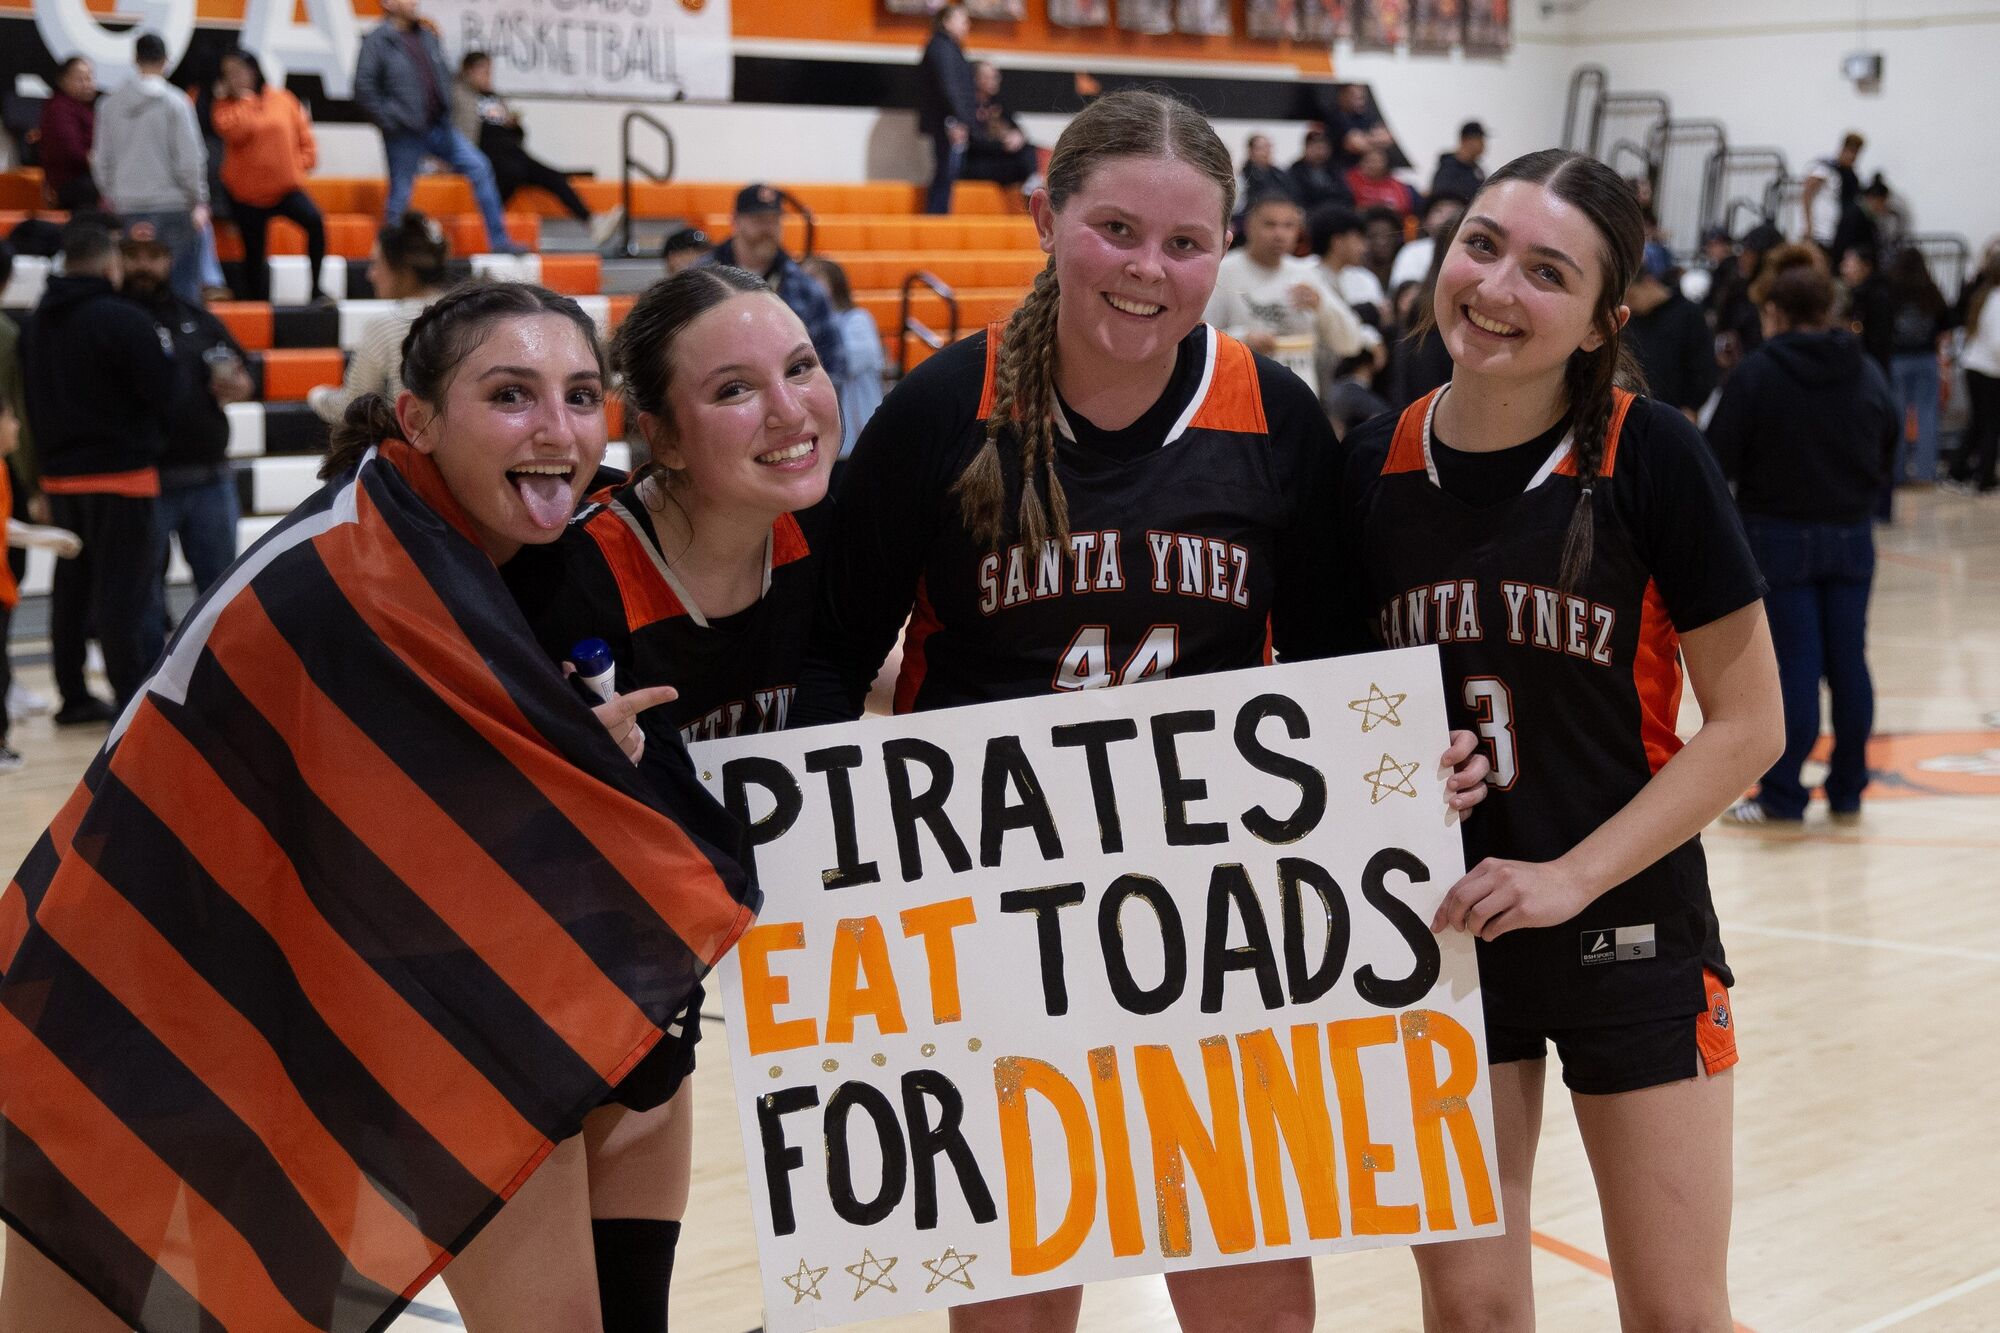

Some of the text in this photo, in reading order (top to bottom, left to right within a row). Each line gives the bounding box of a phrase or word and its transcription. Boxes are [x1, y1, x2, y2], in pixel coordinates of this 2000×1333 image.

[459, 9, 682, 84] BASKETBALL
[978, 529, 1250, 617] SANTA YNEZ
[1052, 624, 1179, 691] 44
[1500, 580, 1616, 667] YNEZ
[1462, 675, 1519, 791] 3
[722, 693, 1328, 890] PIRATES
[738, 847, 1441, 1055] EAT TOADS
[1632, 945, 1641, 956] S
[755, 1009, 1498, 1276] FOR DINNER
